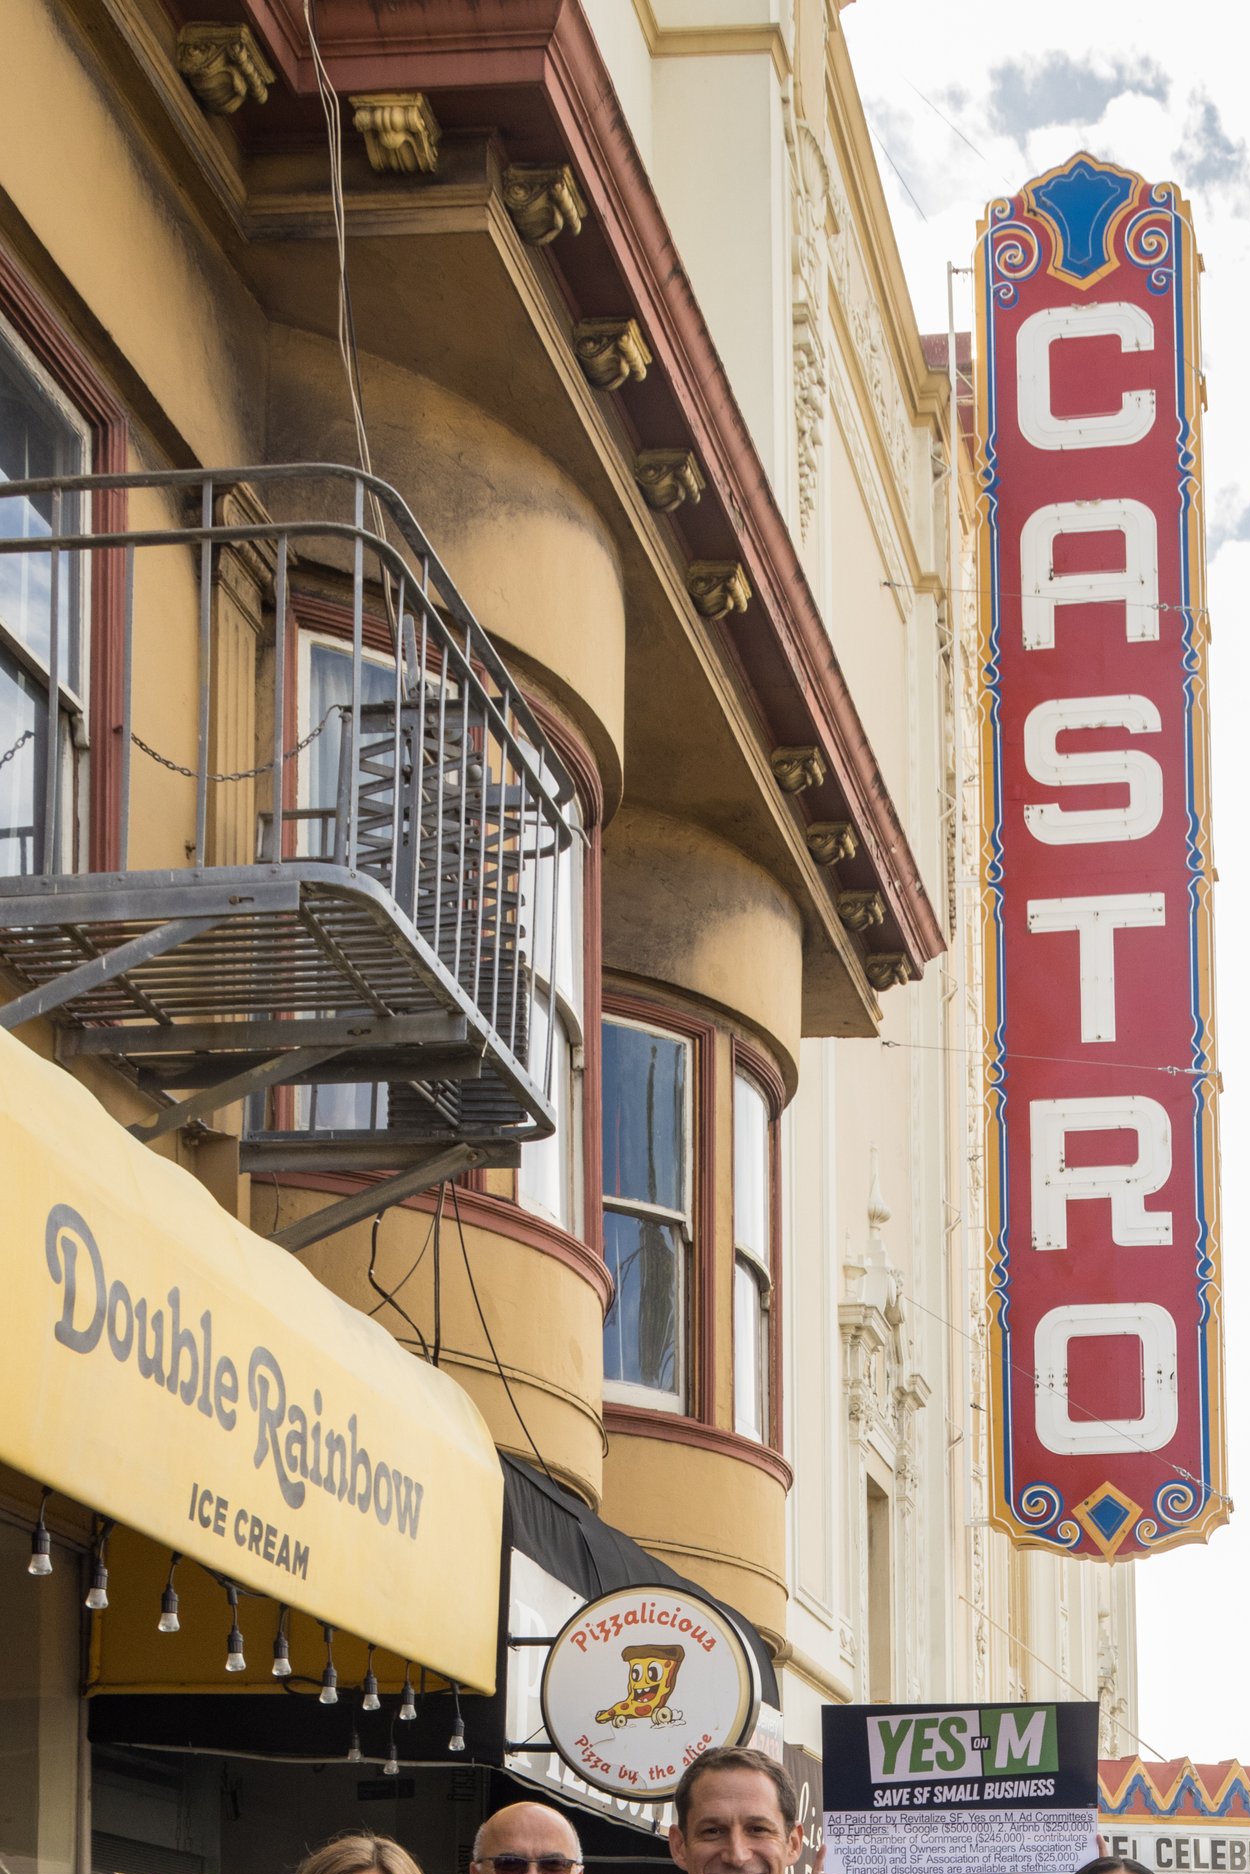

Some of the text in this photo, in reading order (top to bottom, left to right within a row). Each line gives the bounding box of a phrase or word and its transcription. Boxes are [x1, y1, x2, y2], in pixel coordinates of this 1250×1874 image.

[1015, 300, 1178, 1457] CASTRO
[45, 1203, 424, 1540] Double Rainbow
[188, 1482, 311, 1581] ICE CREAM
[569, 1602, 718, 1653] Pizzalicious
[574, 1732, 712, 1785] Pizza by the slice
[879, 1708, 1044, 1774] YES ON M
[873, 1778, 1054, 1807] SAVE SF SMALL BUSINESS
